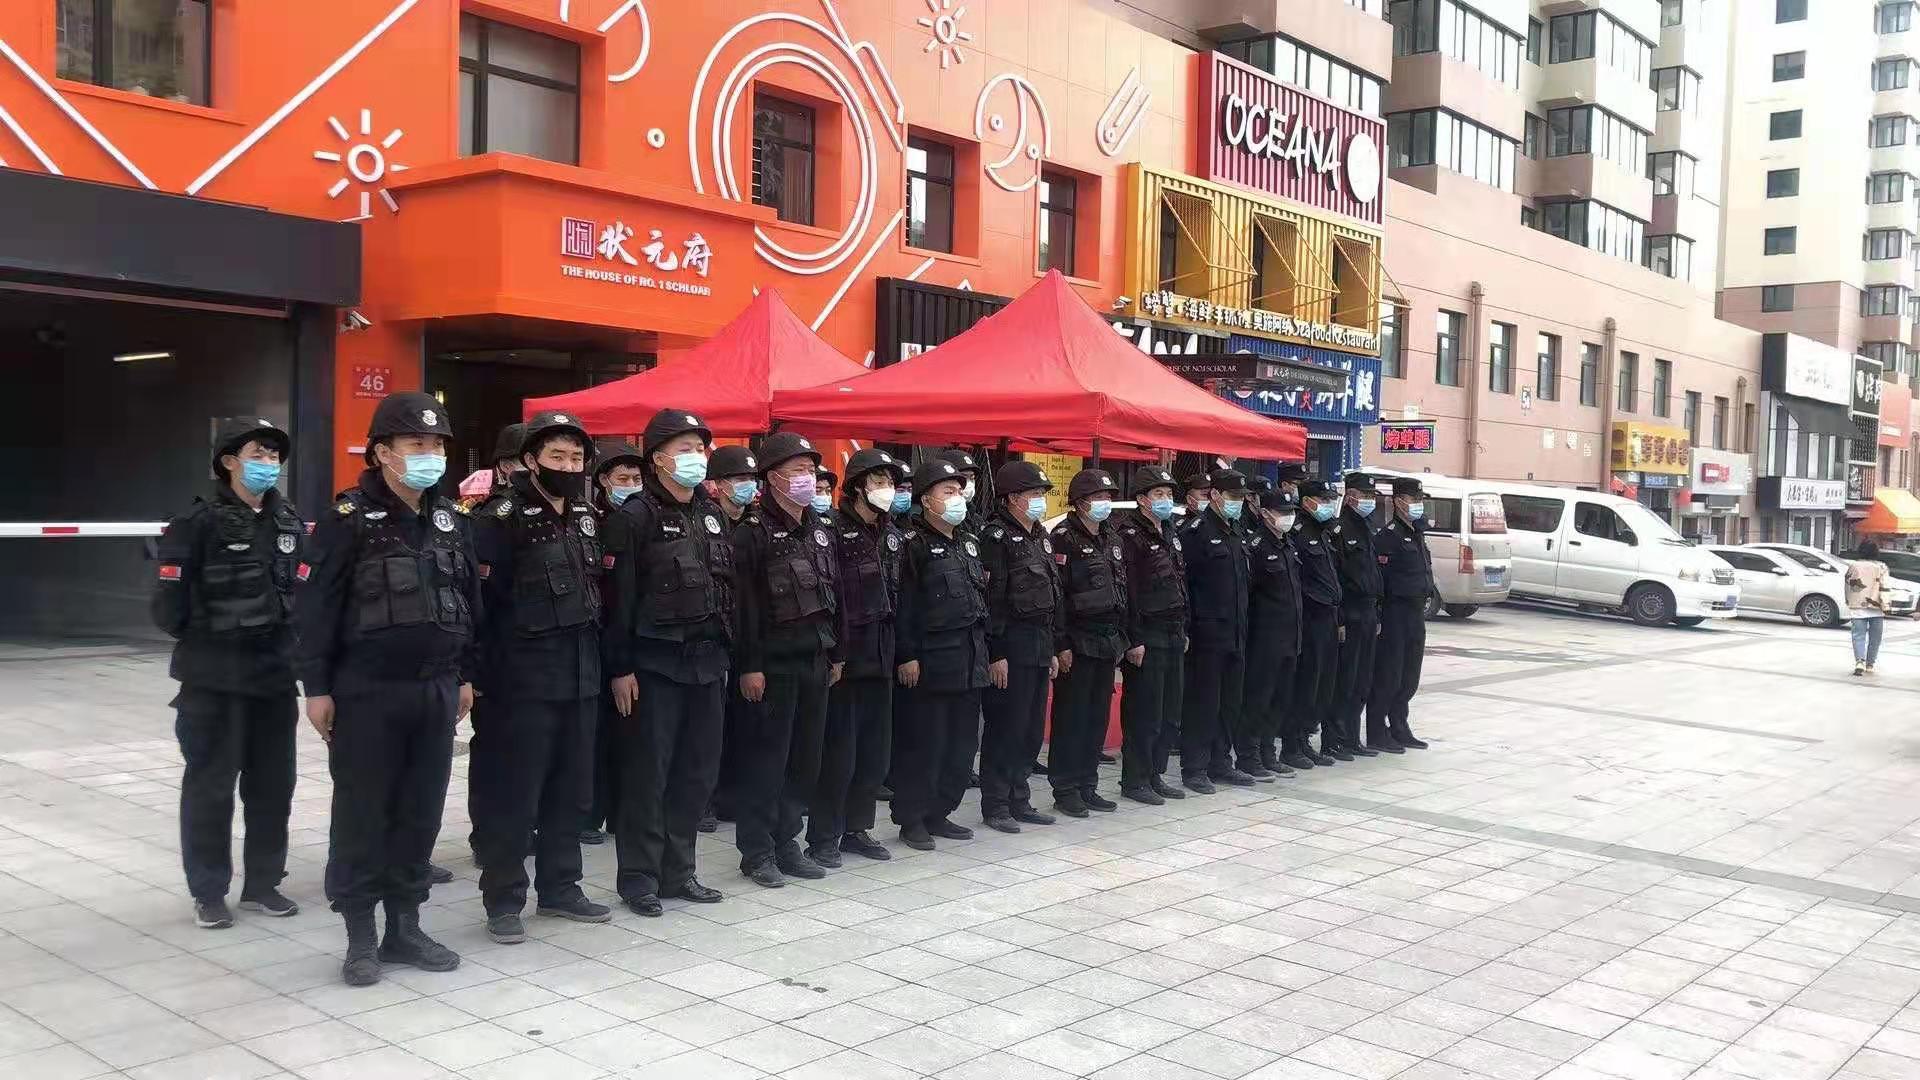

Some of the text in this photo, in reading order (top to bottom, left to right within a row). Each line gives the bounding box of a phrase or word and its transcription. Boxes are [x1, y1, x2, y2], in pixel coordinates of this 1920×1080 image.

[1225, 93, 1342, 190] OCEANA
[597, 218, 712, 277] 状元府
[561, 265, 585, 277] THE
[585, 269, 622, 284] HOUSE
[623, 274, 639, 286] OF
[1292, 317, 1381, 353] Seafood Restaurant
[360, 374, 384, 391] 46
[1385, 428, 1430, 450] 烤羊腿
